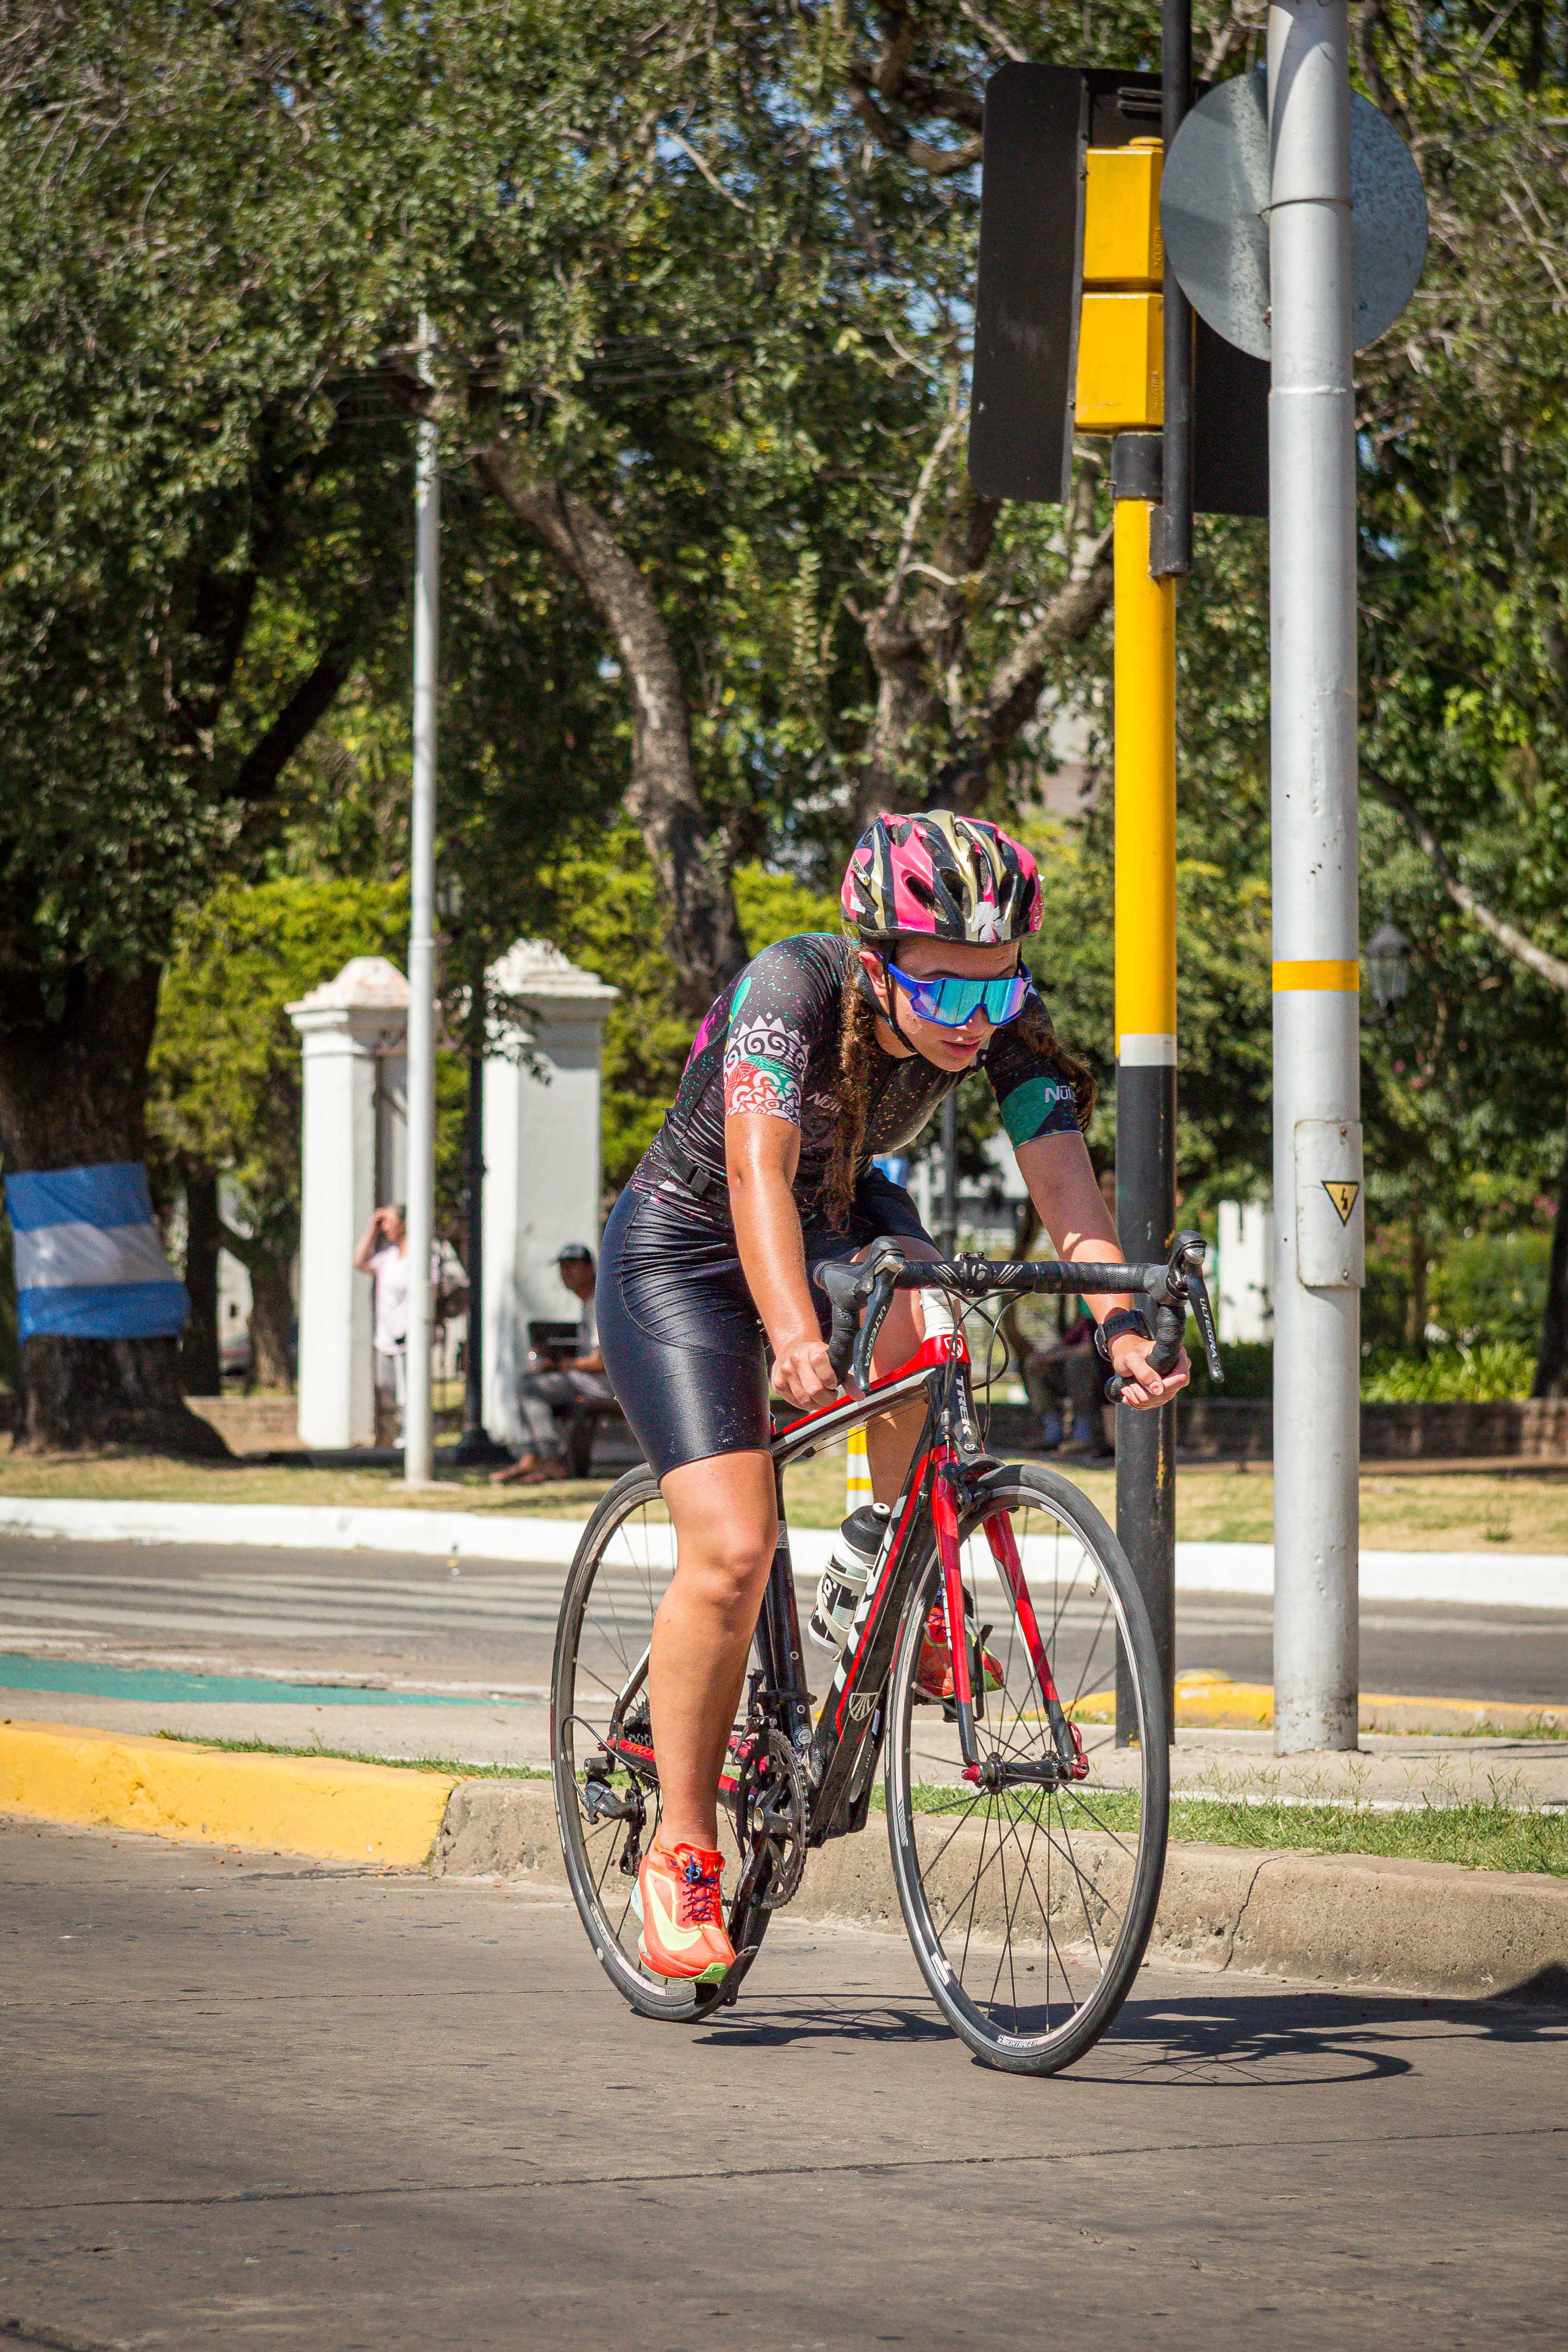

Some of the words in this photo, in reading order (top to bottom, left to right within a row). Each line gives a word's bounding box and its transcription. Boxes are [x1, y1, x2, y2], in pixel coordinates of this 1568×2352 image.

[864, 1305, 886, 1366] ULTEGRA
[1199, 1297, 1218, 1358] ULTEGRA
[956, 1375, 972, 1436] TREK
[1004, 2038, 1038, 2047] BONTRAGER
